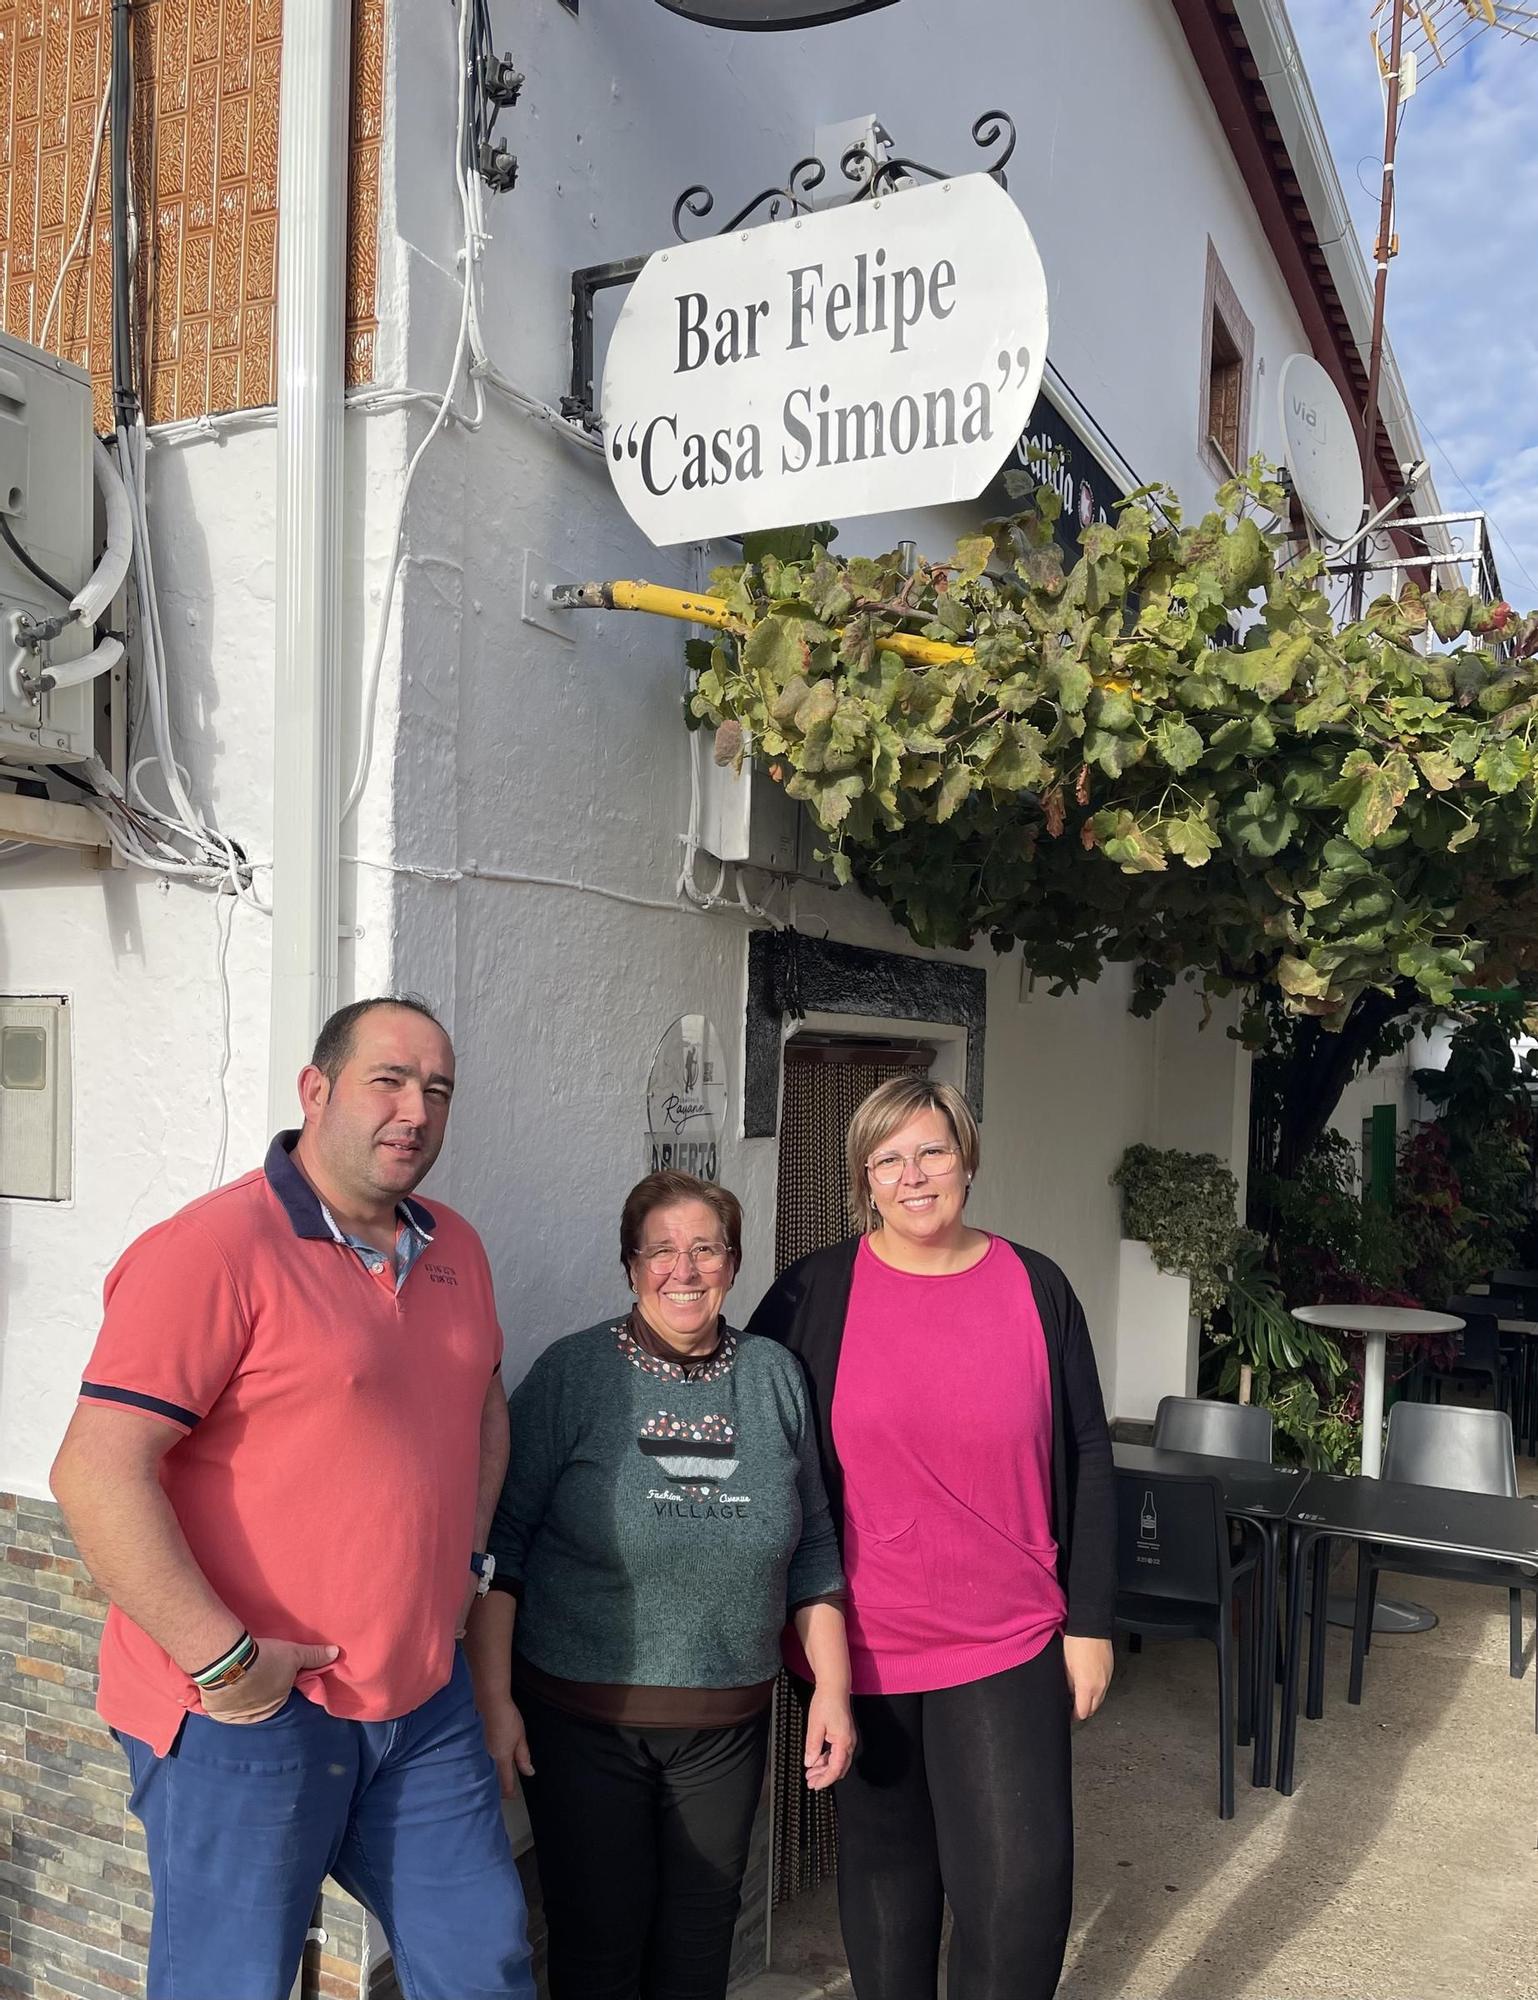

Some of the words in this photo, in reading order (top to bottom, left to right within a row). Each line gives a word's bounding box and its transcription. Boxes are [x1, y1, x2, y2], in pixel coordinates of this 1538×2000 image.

[673, 292, 770, 374] Bar
[785, 247, 957, 354] Felipe
[652, 1142, 717, 1182] ABIERTO
[646, 1489, 684, 1502] Fashion
[654, 1502, 750, 1520] VILLAGE
